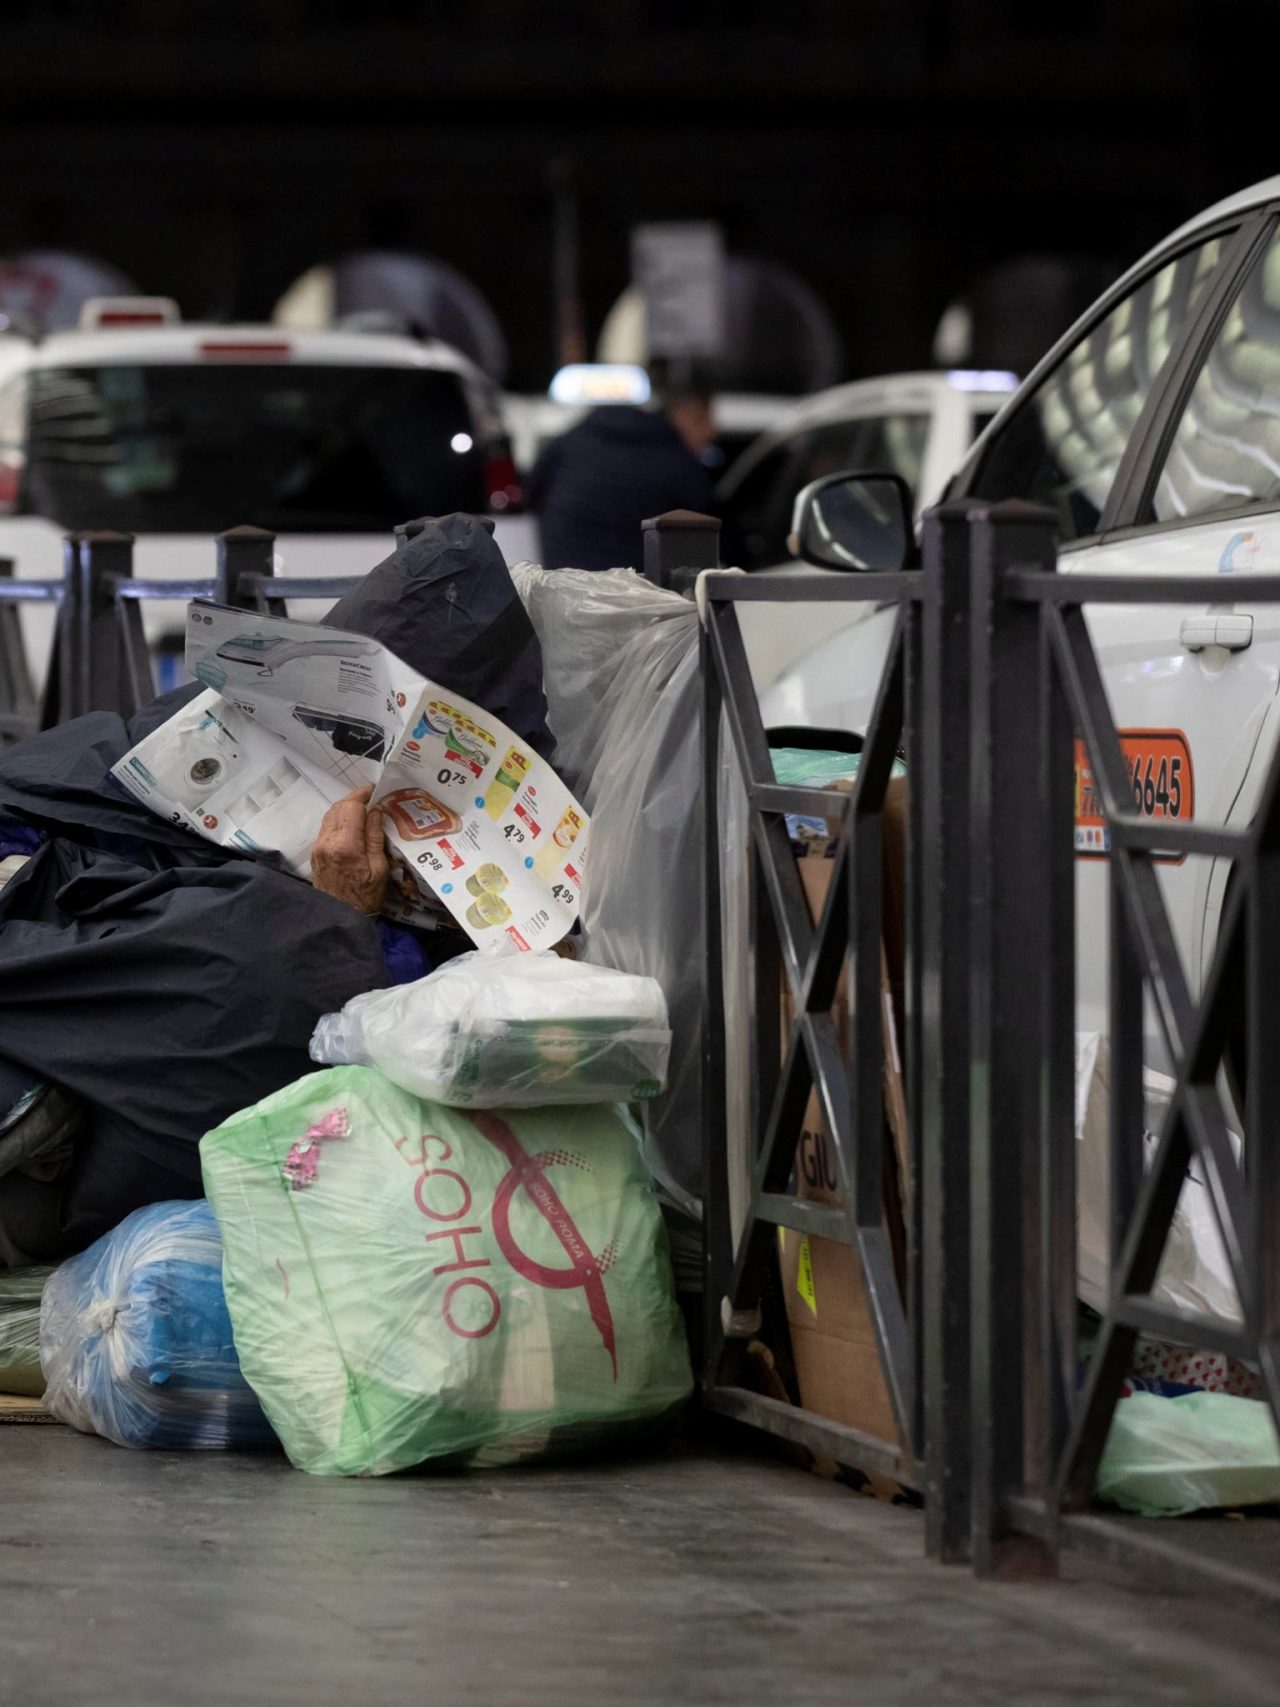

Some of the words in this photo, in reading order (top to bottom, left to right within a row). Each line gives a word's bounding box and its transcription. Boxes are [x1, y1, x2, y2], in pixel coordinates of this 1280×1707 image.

[1132, 755, 1181, 817] 6645
[394, 1134, 502, 1340] SOHO
[528, 1183, 560, 1216] SOHO
[555, 1219, 584, 1259] ROMA
